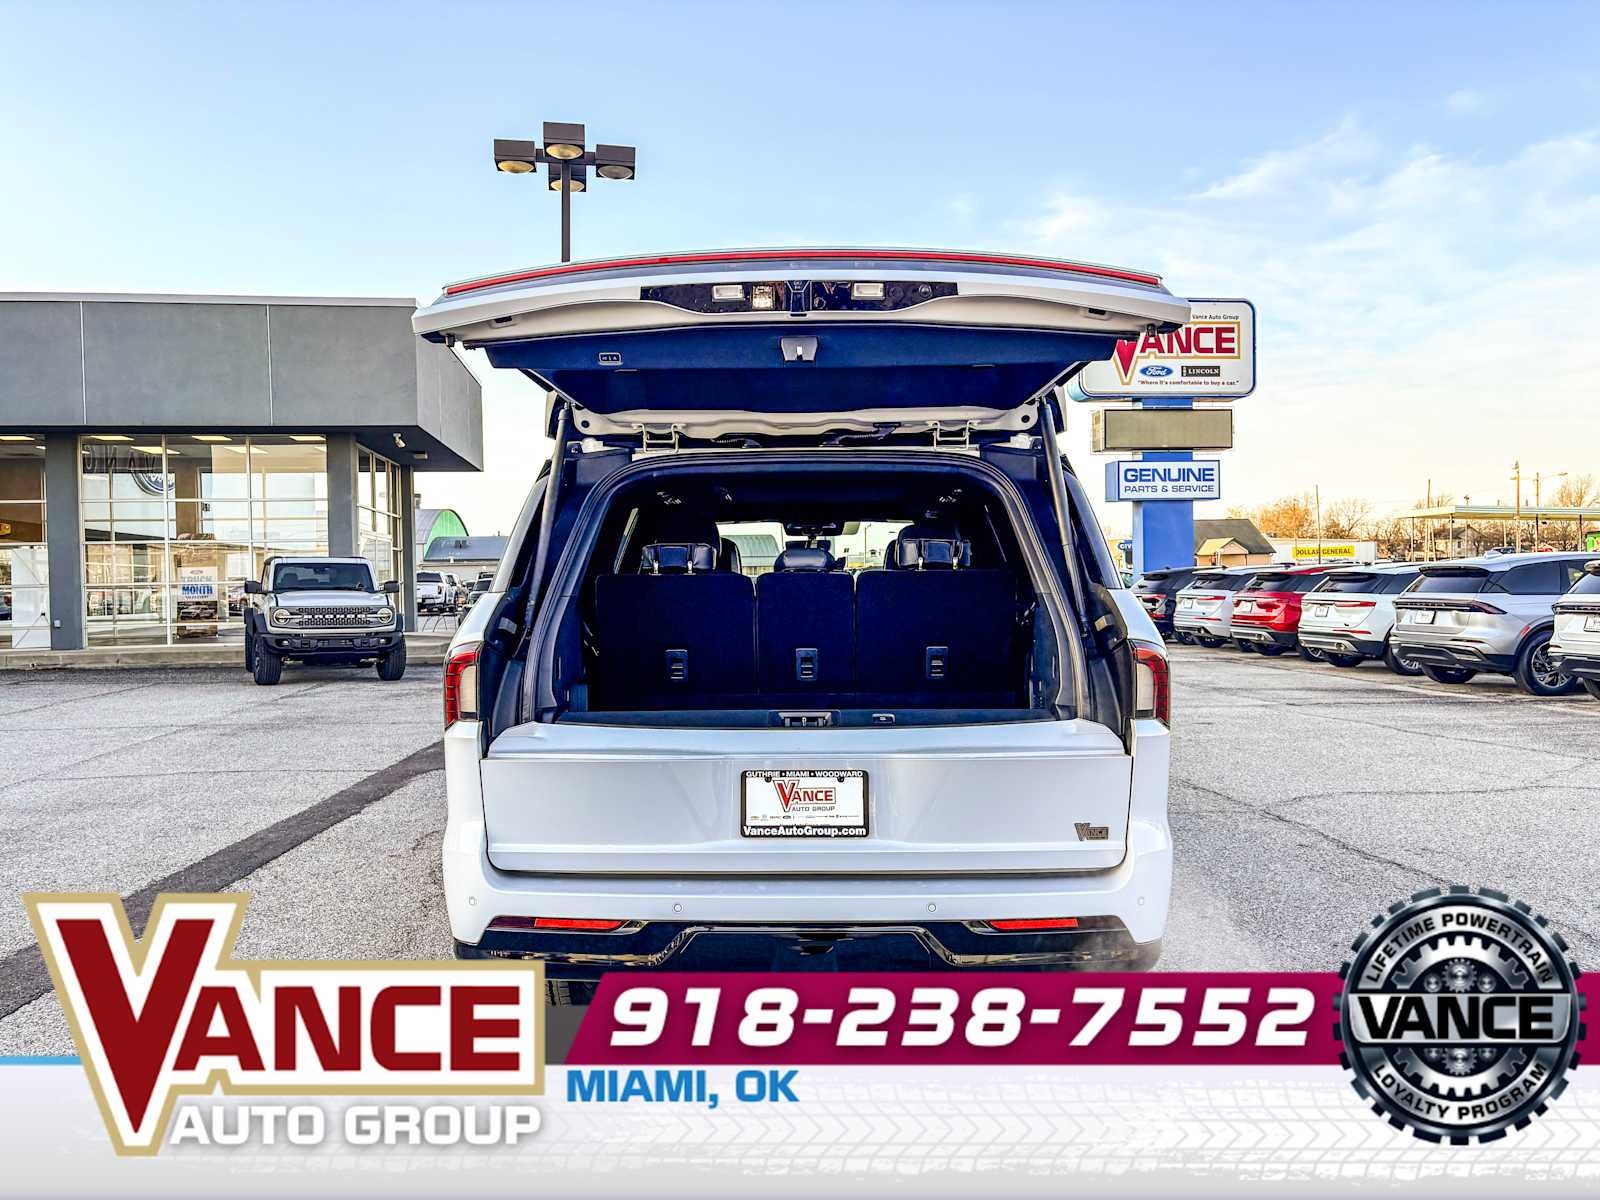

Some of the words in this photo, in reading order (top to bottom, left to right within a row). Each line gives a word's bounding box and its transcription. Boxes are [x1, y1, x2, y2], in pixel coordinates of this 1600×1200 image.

[1116, 327, 1235, 378] VANCE
[1145, 366, 1169, 376] Ford
[1123, 467, 1215, 483] GENUINE
[1124, 485, 1157, 493] PARTS
[1161, 485, 1168, 493] &
[1171, 485, 1214, 493] SERVICE
[1322, 547, 1351, 555] GENERAL
[182, 585, 213, 595] MONTH
[776, 781, 834, 809] VANCE
[743, 826, 866, 837] VanceAutoGroup.com
